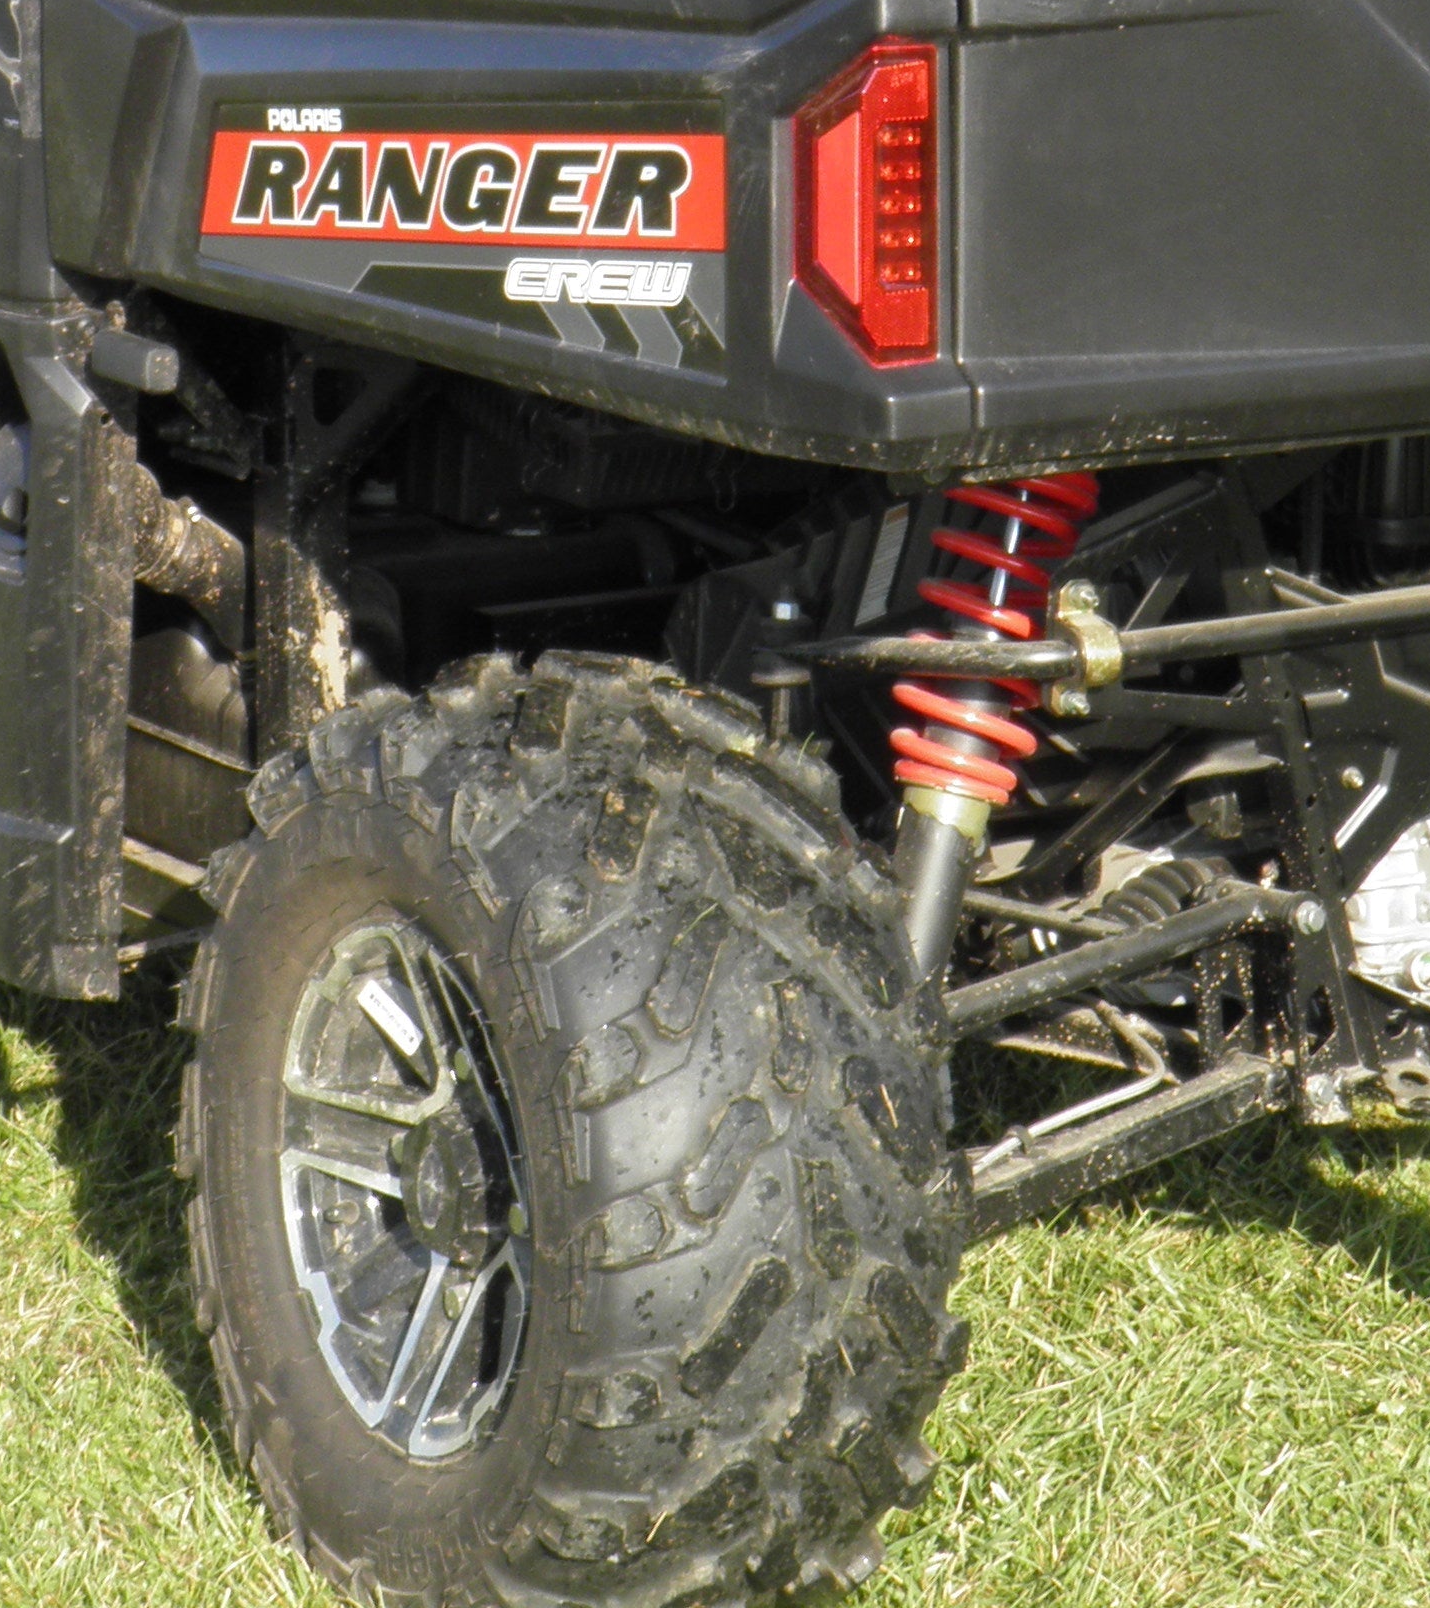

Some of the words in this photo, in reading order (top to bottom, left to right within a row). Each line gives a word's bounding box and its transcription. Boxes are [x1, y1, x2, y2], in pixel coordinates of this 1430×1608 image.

[267, 107, 343, 132] POLARIS
[231, 139, 692, 237] RANGER
[504, 257, 693, 307] CREW
